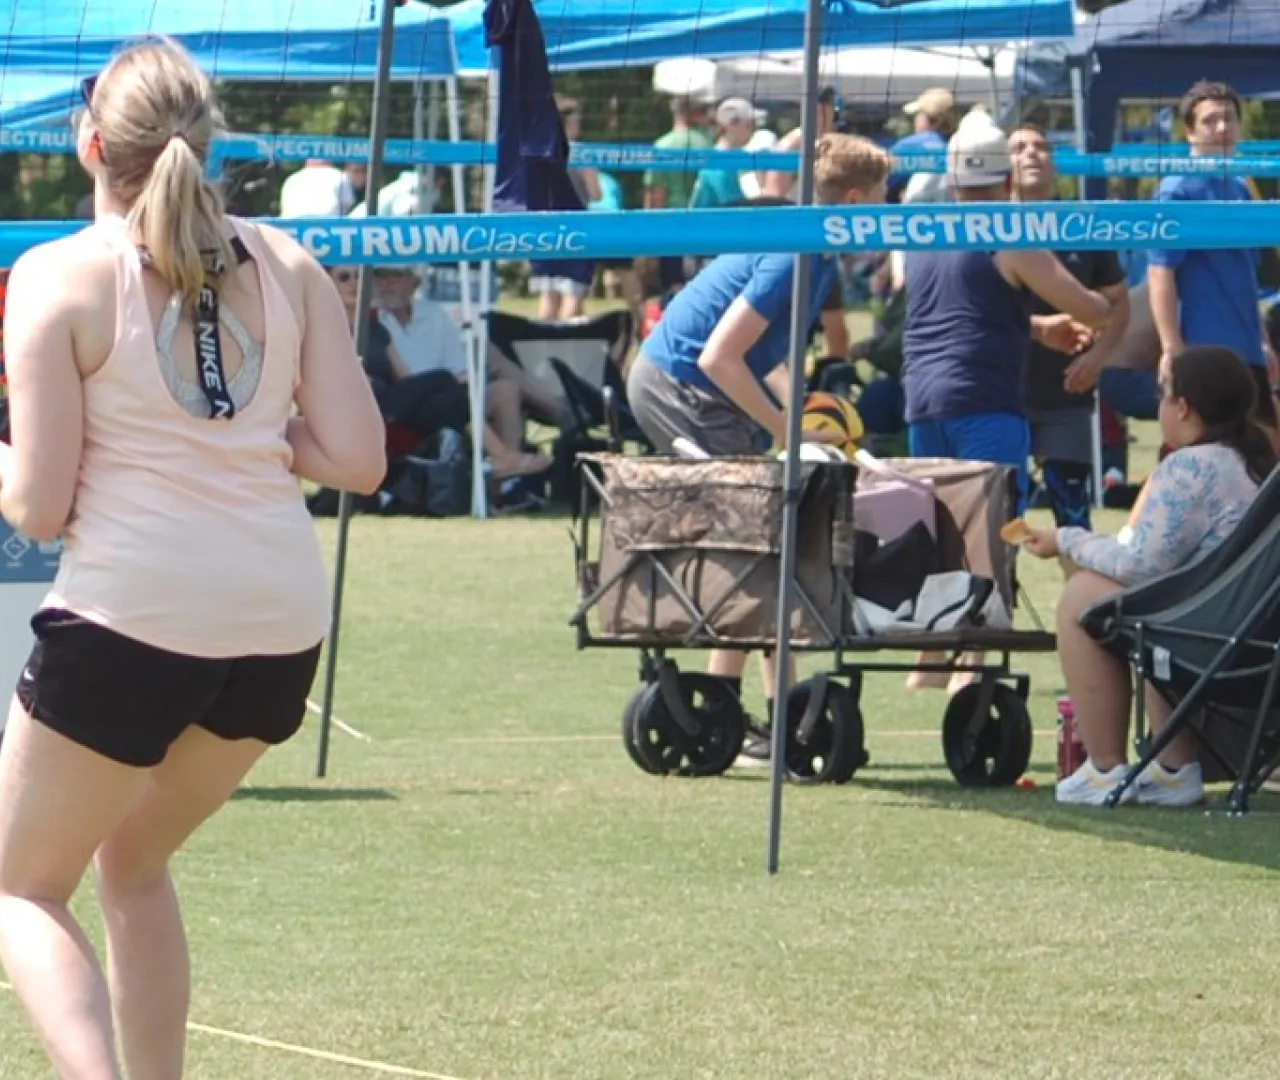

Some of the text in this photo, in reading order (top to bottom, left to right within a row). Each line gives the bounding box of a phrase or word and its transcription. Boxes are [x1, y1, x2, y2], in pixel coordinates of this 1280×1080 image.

[287, 223, 588, 258] CTRUM Classic
[824, 211, 1181, 246] SPECTRUM Classic
[199, 322, 222, 392] NIKE
